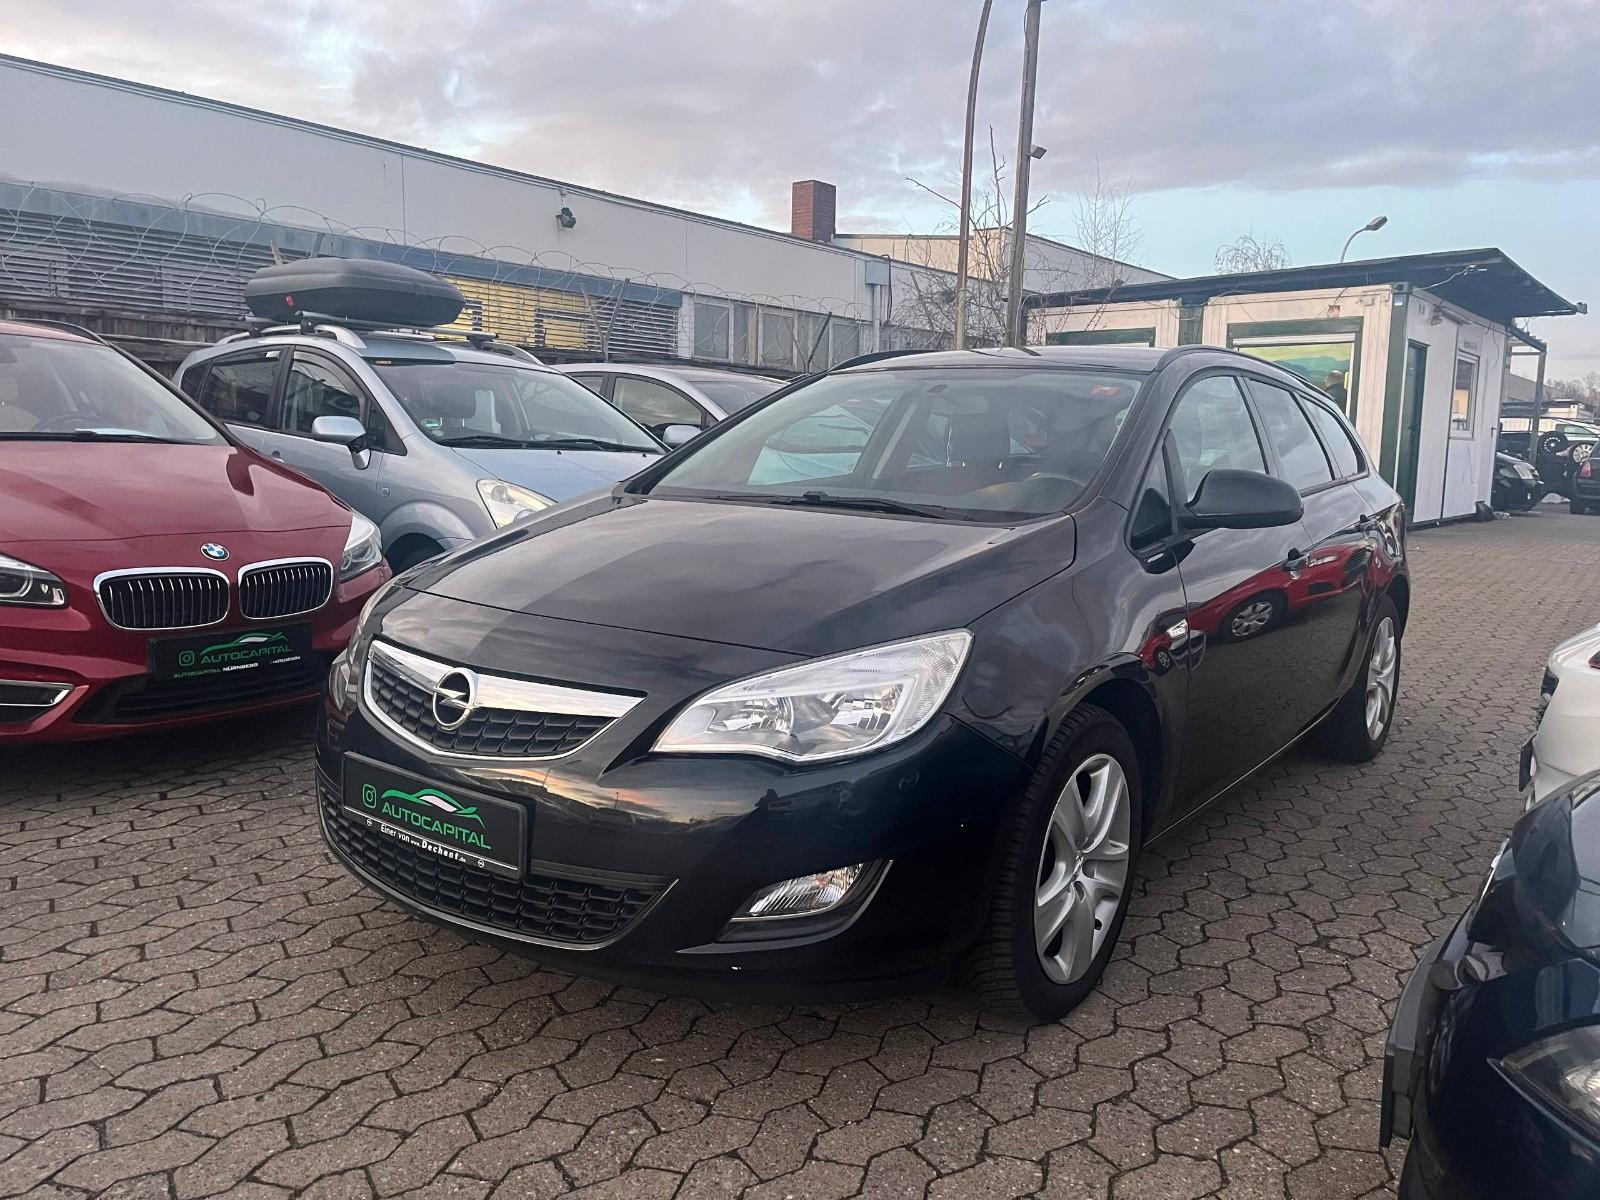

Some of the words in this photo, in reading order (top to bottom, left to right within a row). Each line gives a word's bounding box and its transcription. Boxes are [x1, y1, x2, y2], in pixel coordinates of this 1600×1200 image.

[200, 645, 293, 664] AUTOCAPITAL
[380, 824, 396, 837] Einer
[397, 832, 410, 843] von
[382, 802, 492, 849] AUTOCAPITAL
